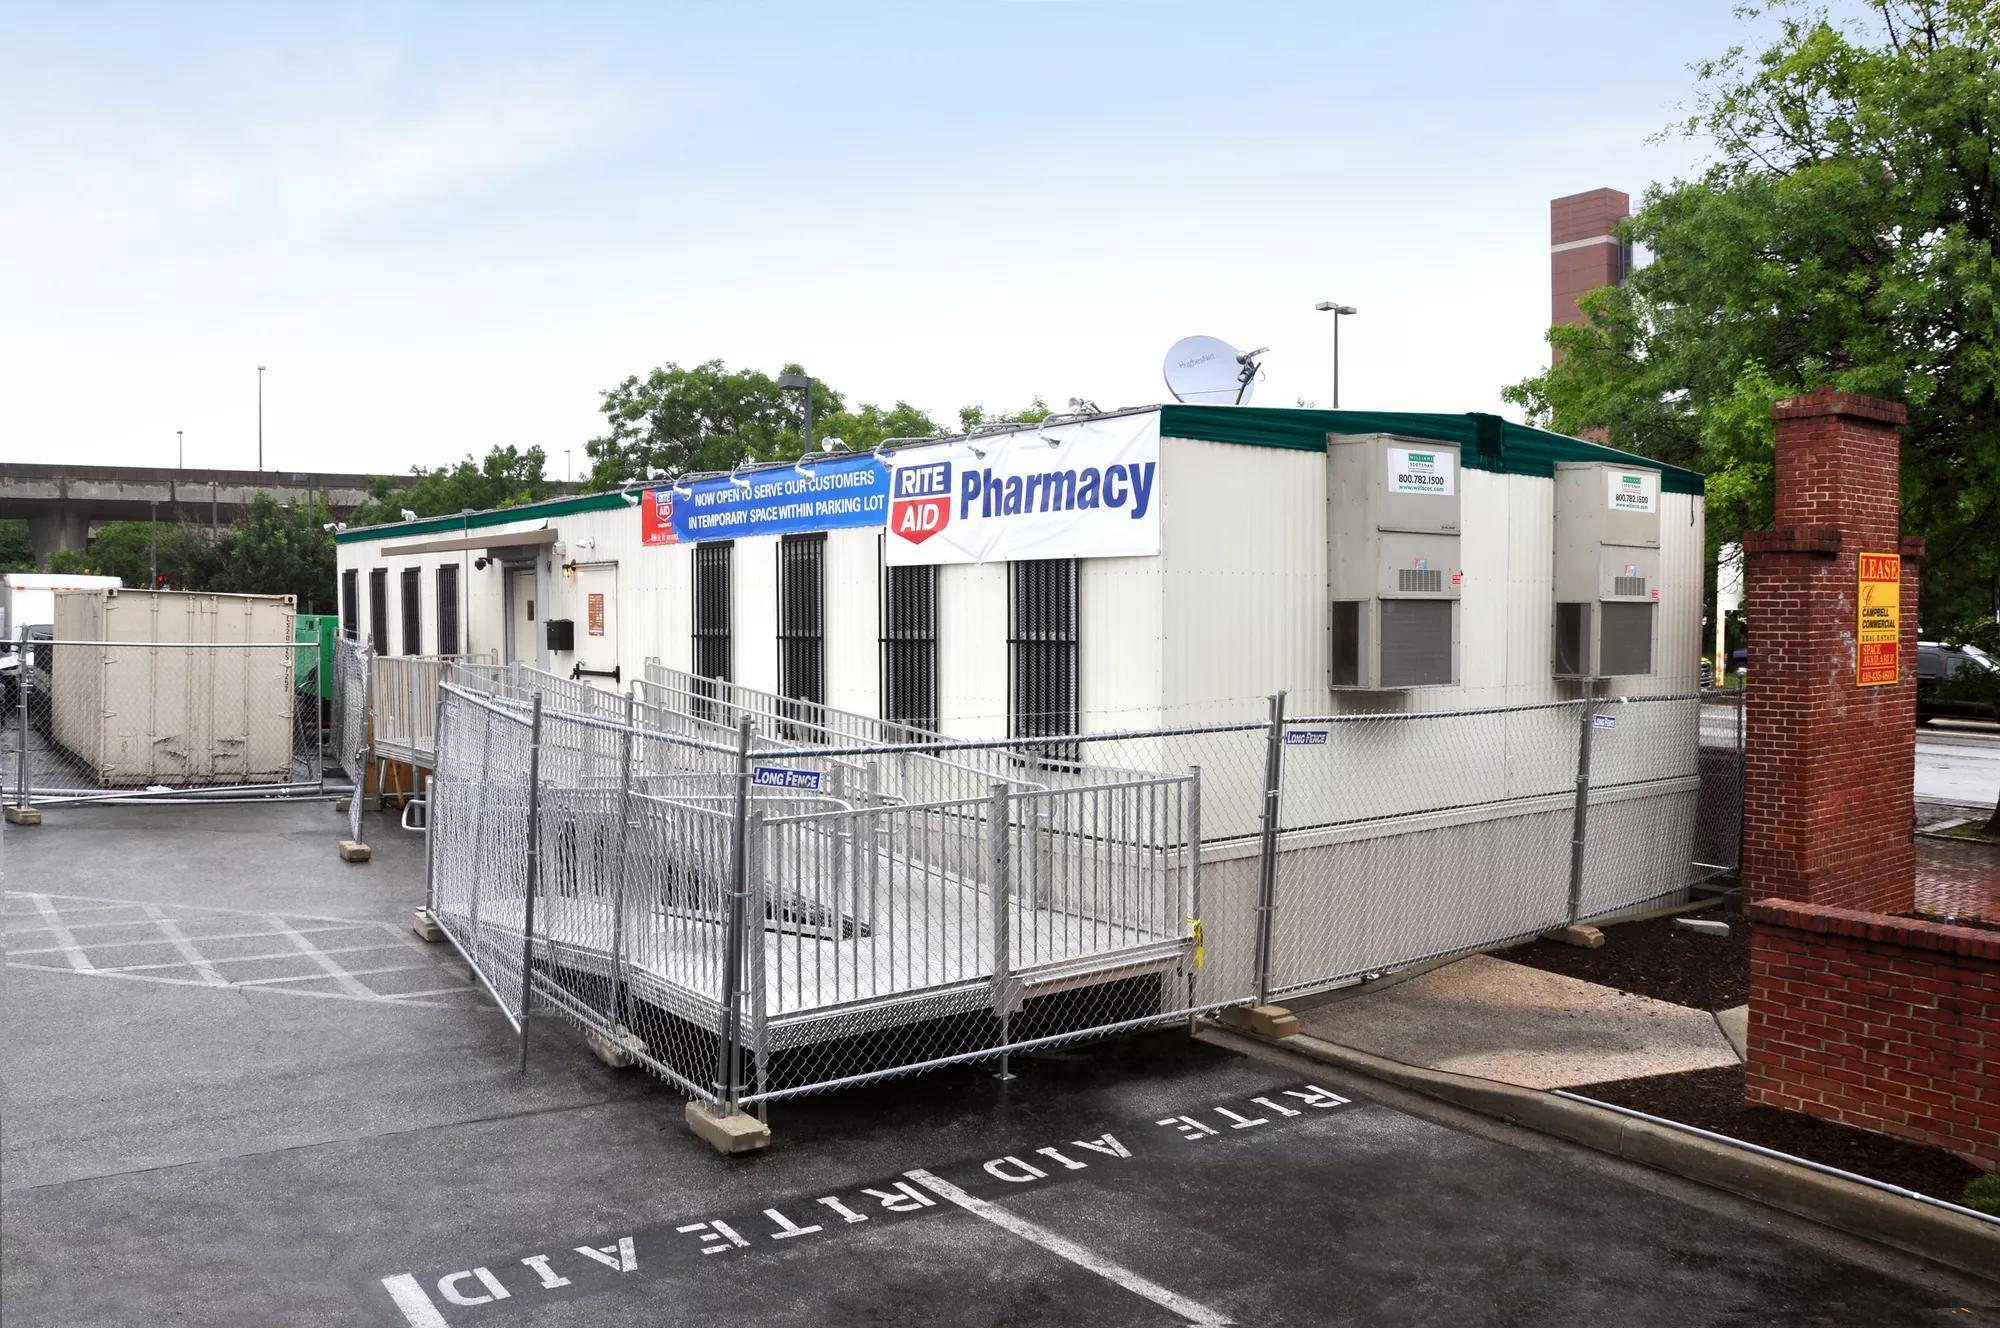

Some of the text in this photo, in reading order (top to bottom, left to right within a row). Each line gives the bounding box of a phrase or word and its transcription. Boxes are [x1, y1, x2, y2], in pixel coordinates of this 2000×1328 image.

[901, 465, 945, 495] RITE
[1398, 474, 1444, 485] 800.782.1500
[695, 492, 716, 507] NOW
[716, 490, 739, 504] OPEN
[754, 483, 783, 499] SERVE
[785, 479, 806, 494] OUR
[808, 469, 875, 490] CUSTOMERS
[960, 461, 1156, 520] Pharmacy
[658, 494, 671, 503] RITE
[1615, 494, 1648, 504] 800.782.1500
[659, 505, 670, 516] AID
[688, 494, 885, 529] IN TEMPORARY SPACE WITHIN PARKING LOT
[900, 503, 939, 532] AID
[1861, 558, 1898, 579] LEASE
[1862, 608, 1889, 617] CAMPBELL
[1862, 619, 1895, 629] COMMERCIAL
[1863, 644, 1881, 655] SPACE
[1863, 654, 1895, 666] AVAILABLE
[1287, 731, 1326, 743] LONG FENCE
[754, 768, 817, 788] LONG FENCE
[982, 1085, 1353, 1182] RITE AID
[437, 1182, 936, 1306] RITE AID
